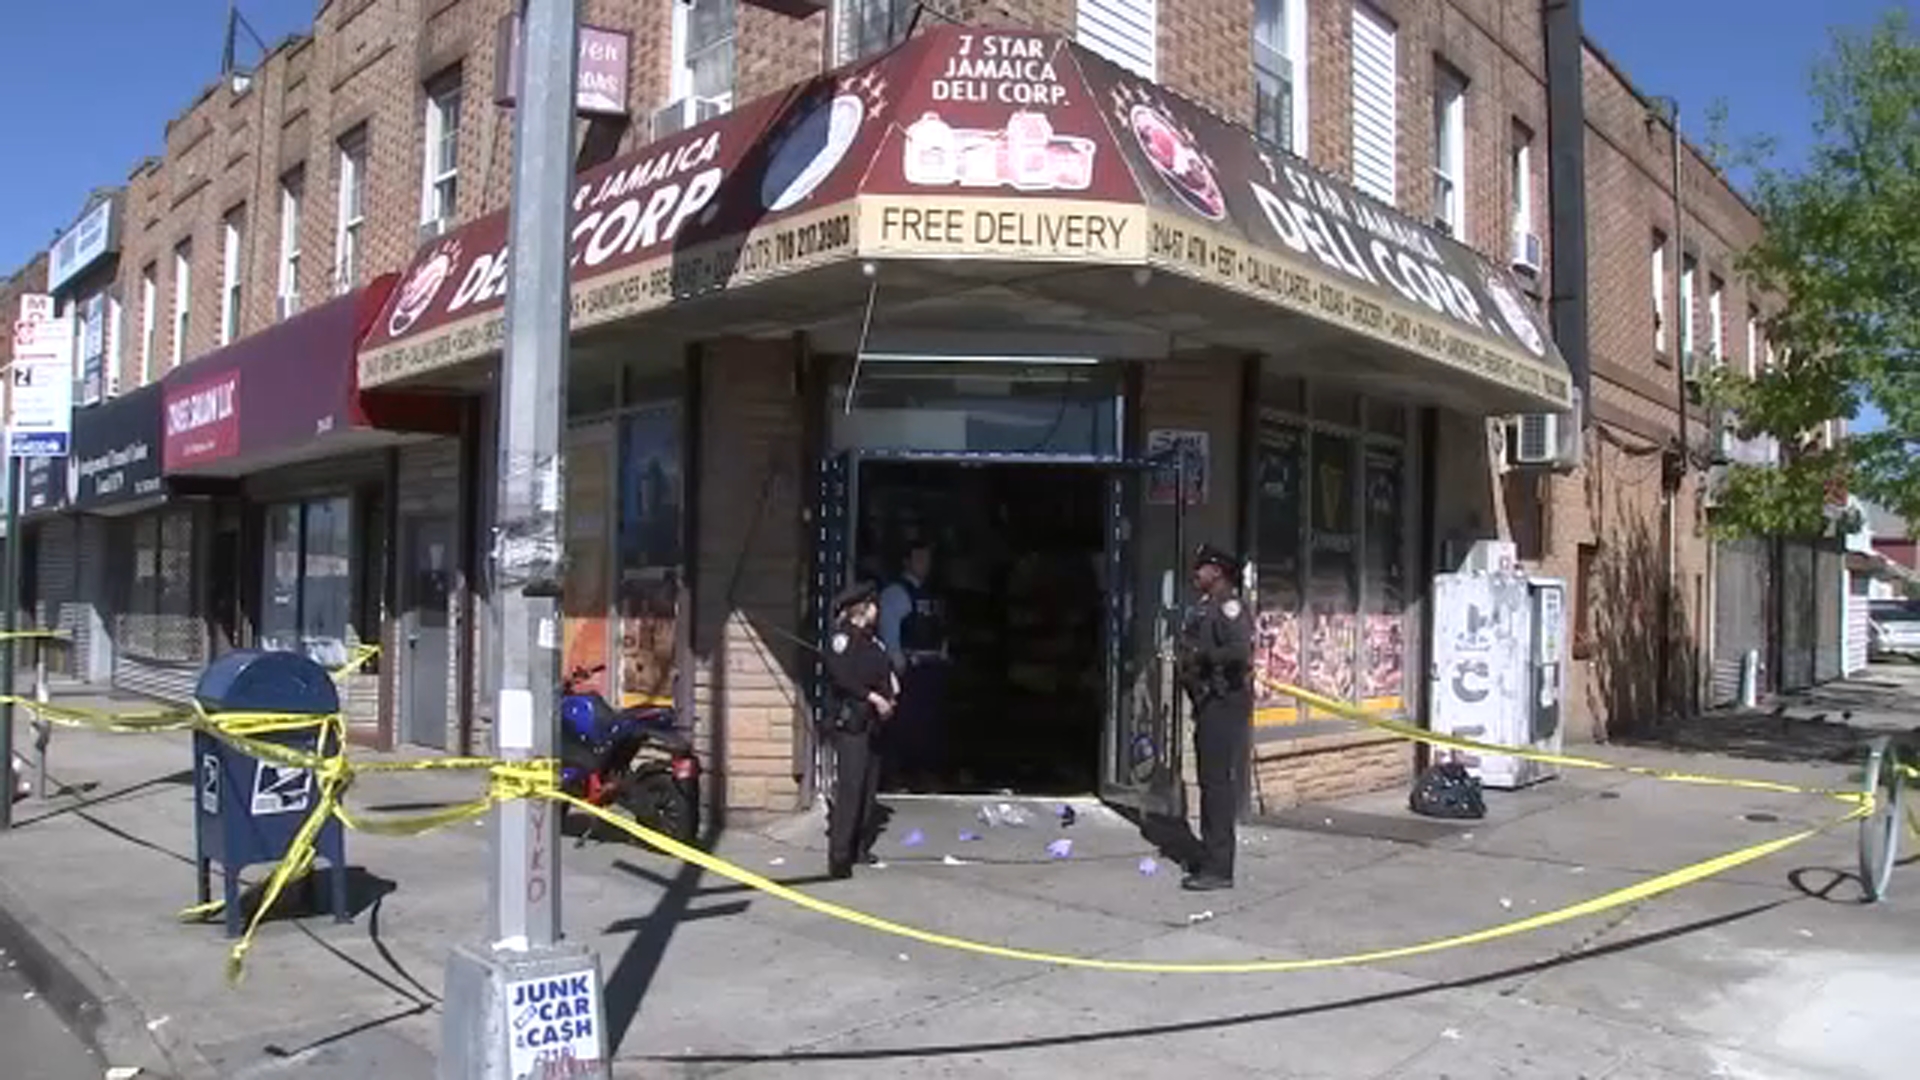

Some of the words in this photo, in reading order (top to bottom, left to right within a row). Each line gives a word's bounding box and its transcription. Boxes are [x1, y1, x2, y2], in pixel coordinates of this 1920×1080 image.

[960, 36, 973, 57] 7
[984, 36, 1043, 57] STAR
[945, 58, 1057, 81] JAMAICA
[932, 80, 987, 101] DELI
[997, 82, 1070, 105] CORP.
[591, 132, 720, 205] JAMAICA
[882, 207, 964, 243] FREE
[975, 212, 1127, 249] DELIVERY
[1250, 183, 1380, 287] DELI
[514, 975, 588, 1006] JUNK
[539, 998, 590, 1021] CAR
